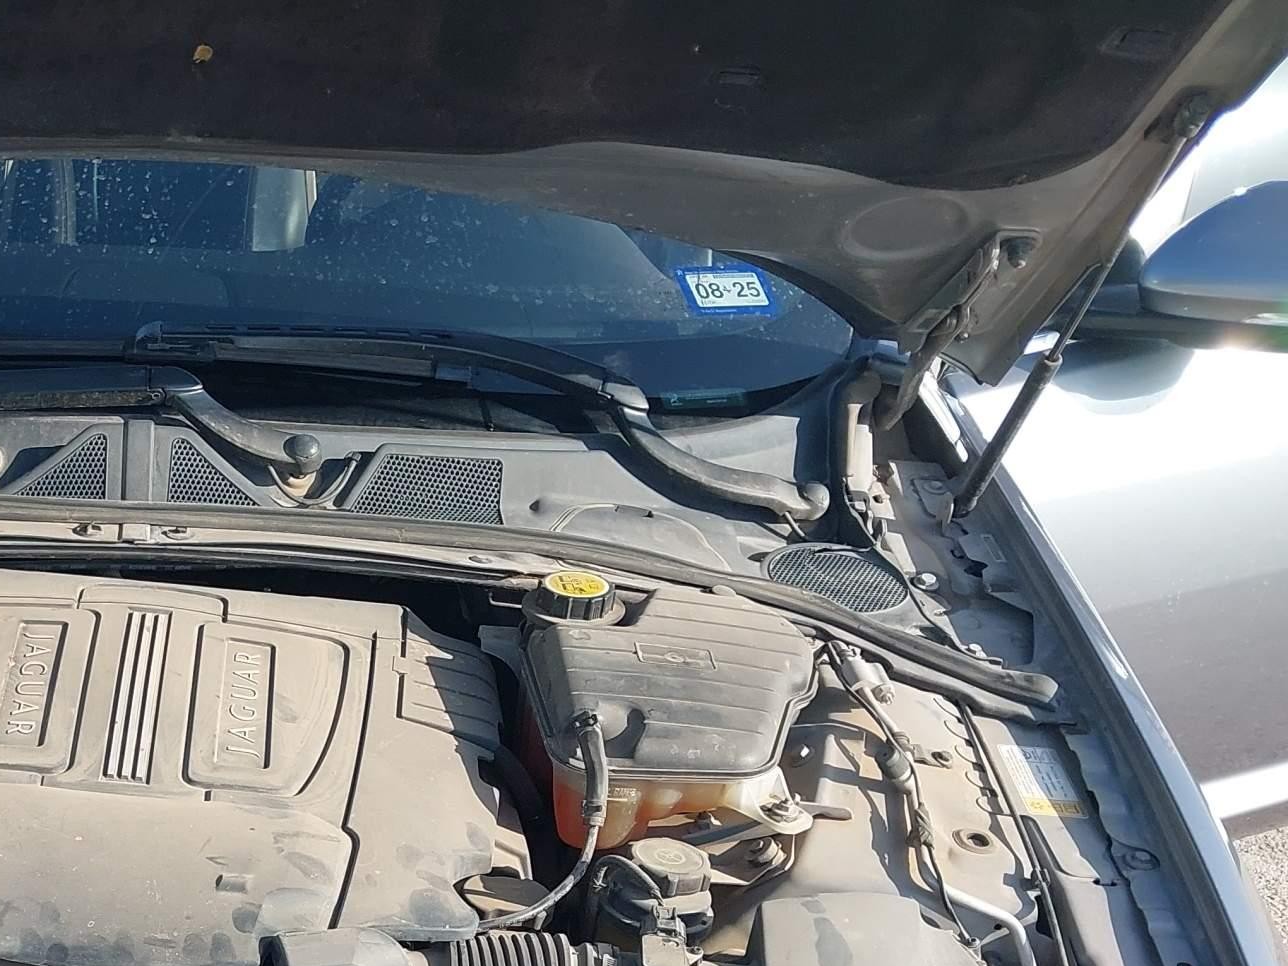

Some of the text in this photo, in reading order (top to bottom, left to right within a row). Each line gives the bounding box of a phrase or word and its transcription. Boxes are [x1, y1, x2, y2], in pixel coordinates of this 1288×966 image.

[694, 281, 760, 299] 08 25
[5, 632, 56, 735] JAGUAR
[225, 652, 261, 759] JAGUAR
